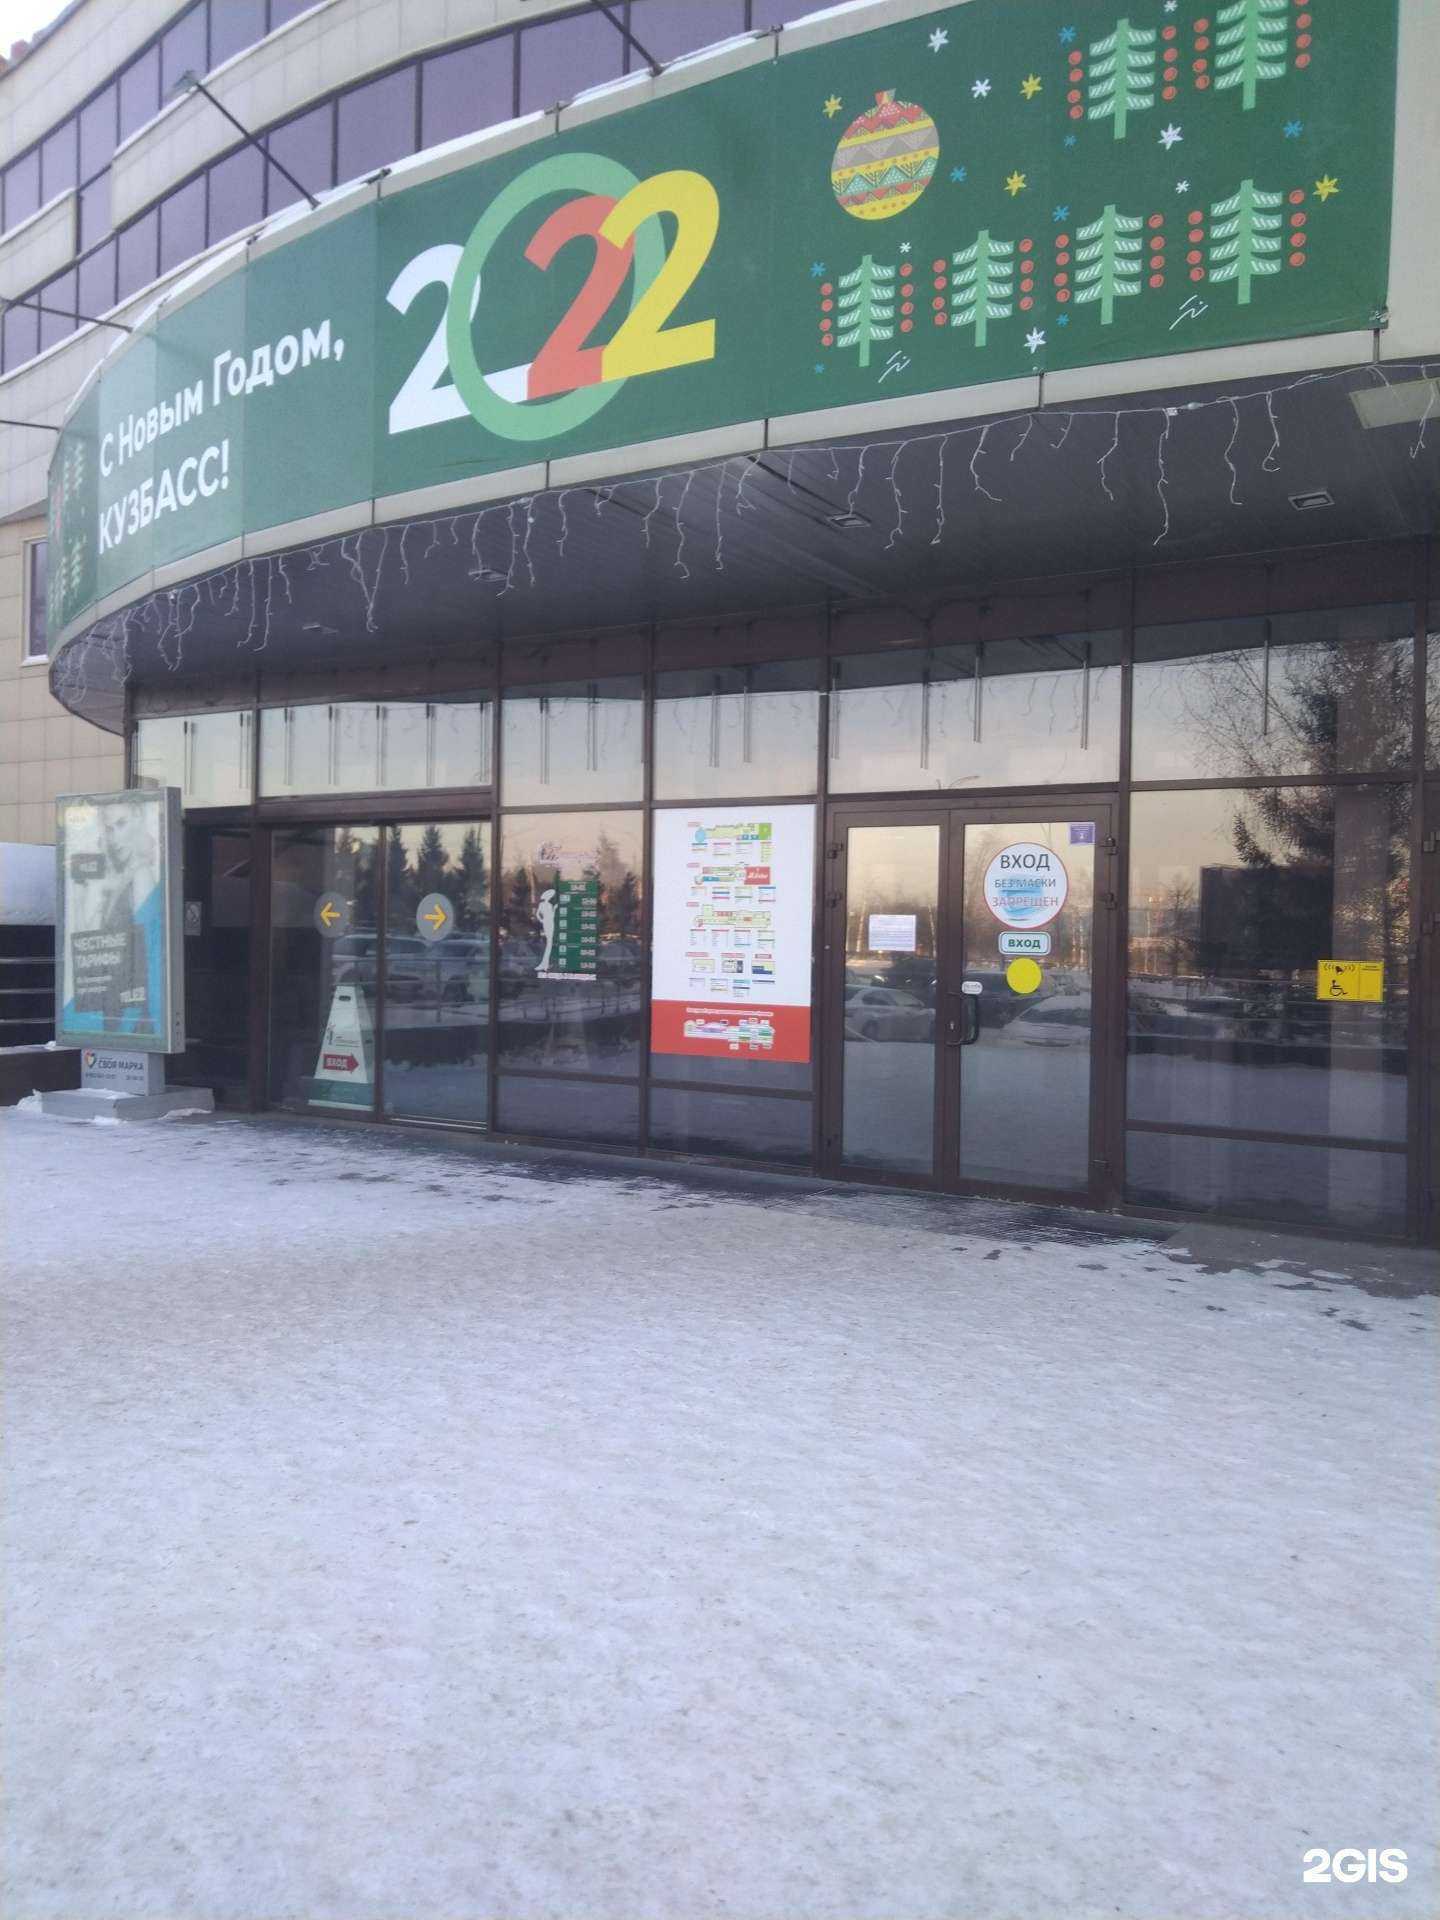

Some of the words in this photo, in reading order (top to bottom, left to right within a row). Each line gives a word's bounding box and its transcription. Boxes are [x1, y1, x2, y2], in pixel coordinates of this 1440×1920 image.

[386, 152, 719, 441] 2022
[100, 432, 114, 477] С
[119, 379, 204, 466] Новым
[213, 319, 345, 406] Годом,
[99, 438, 230, 555] КУЗБАСС!
[994, 879, 1014, 888] БЕЗ
[1000, 853, 1051, 872] ВХОД
